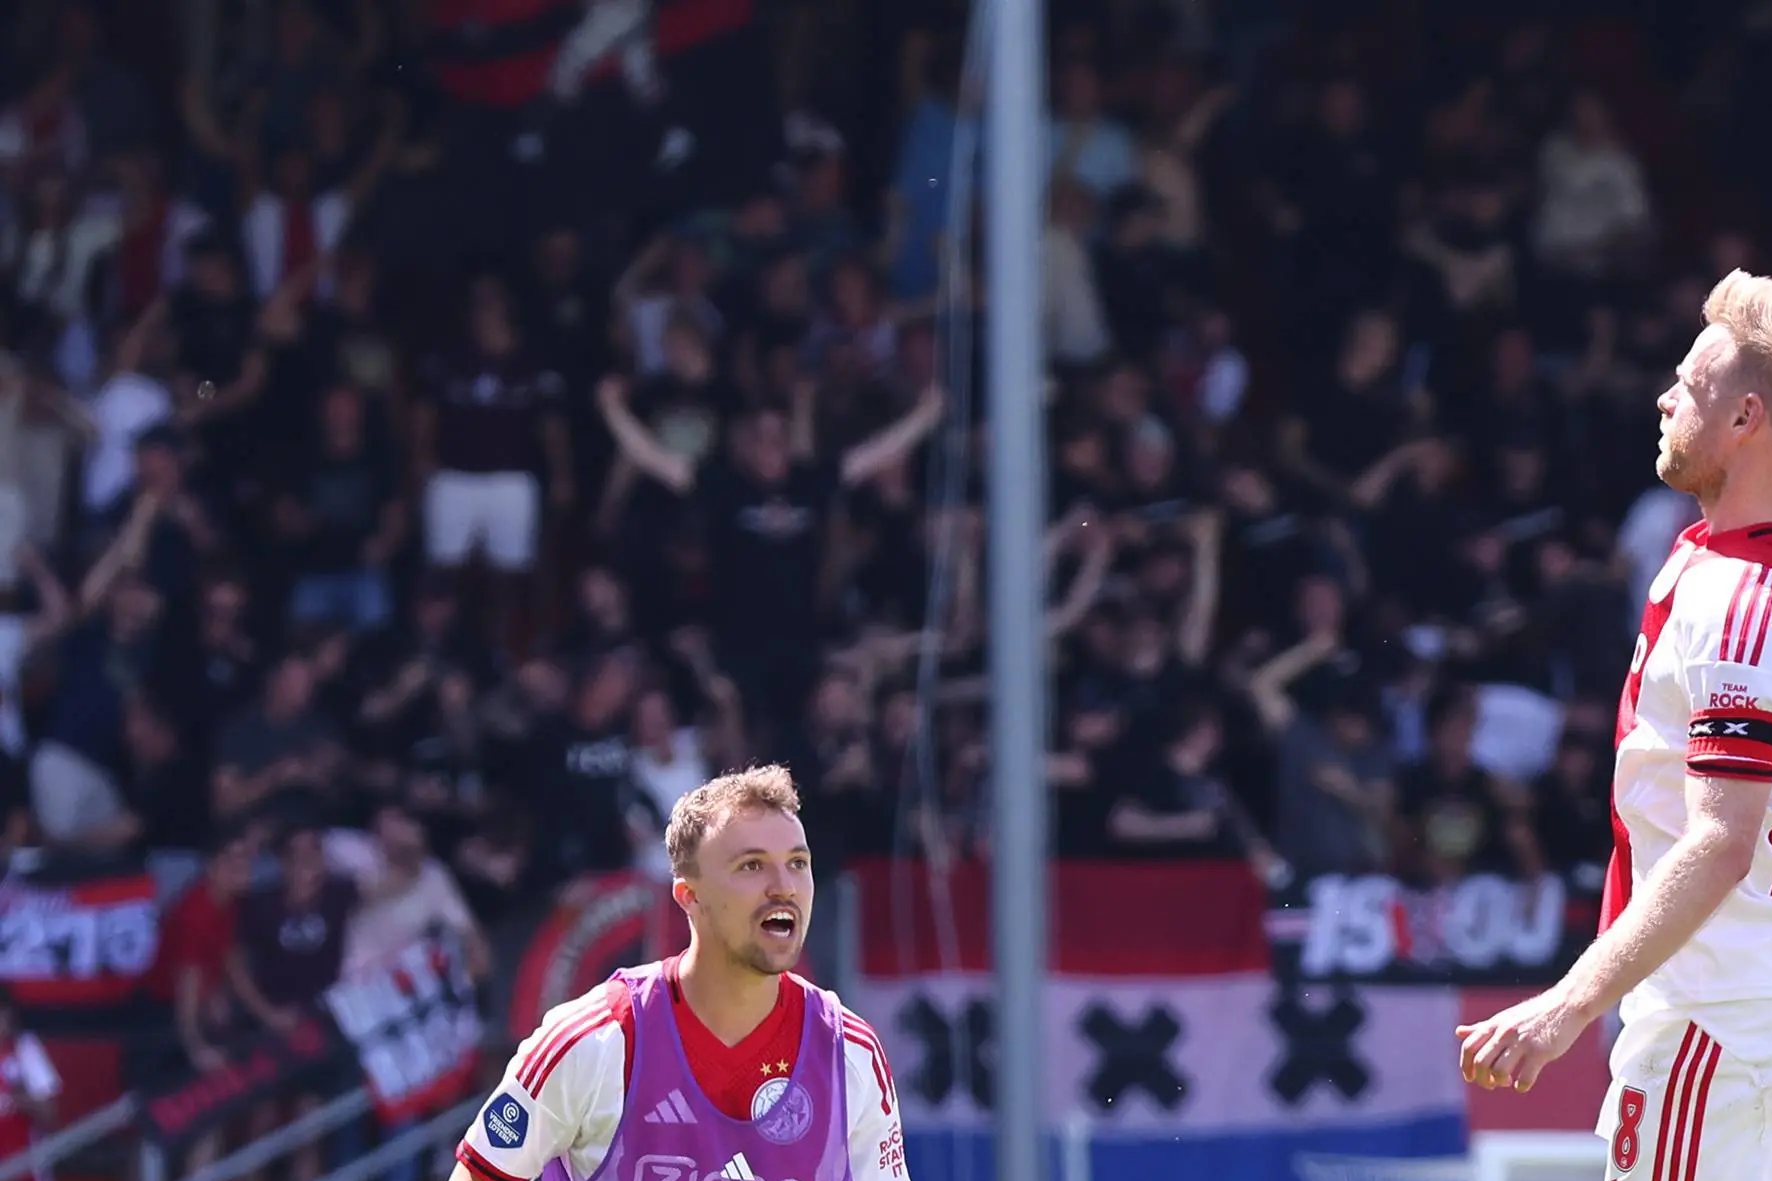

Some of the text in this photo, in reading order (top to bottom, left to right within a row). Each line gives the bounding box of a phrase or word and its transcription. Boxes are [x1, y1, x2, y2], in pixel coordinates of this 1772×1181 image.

[1721, 683, 1748, 693] TEAM
[1709, 692, 1760, 709] ROCK
[1612, 1085, 1647, 1172] 8
